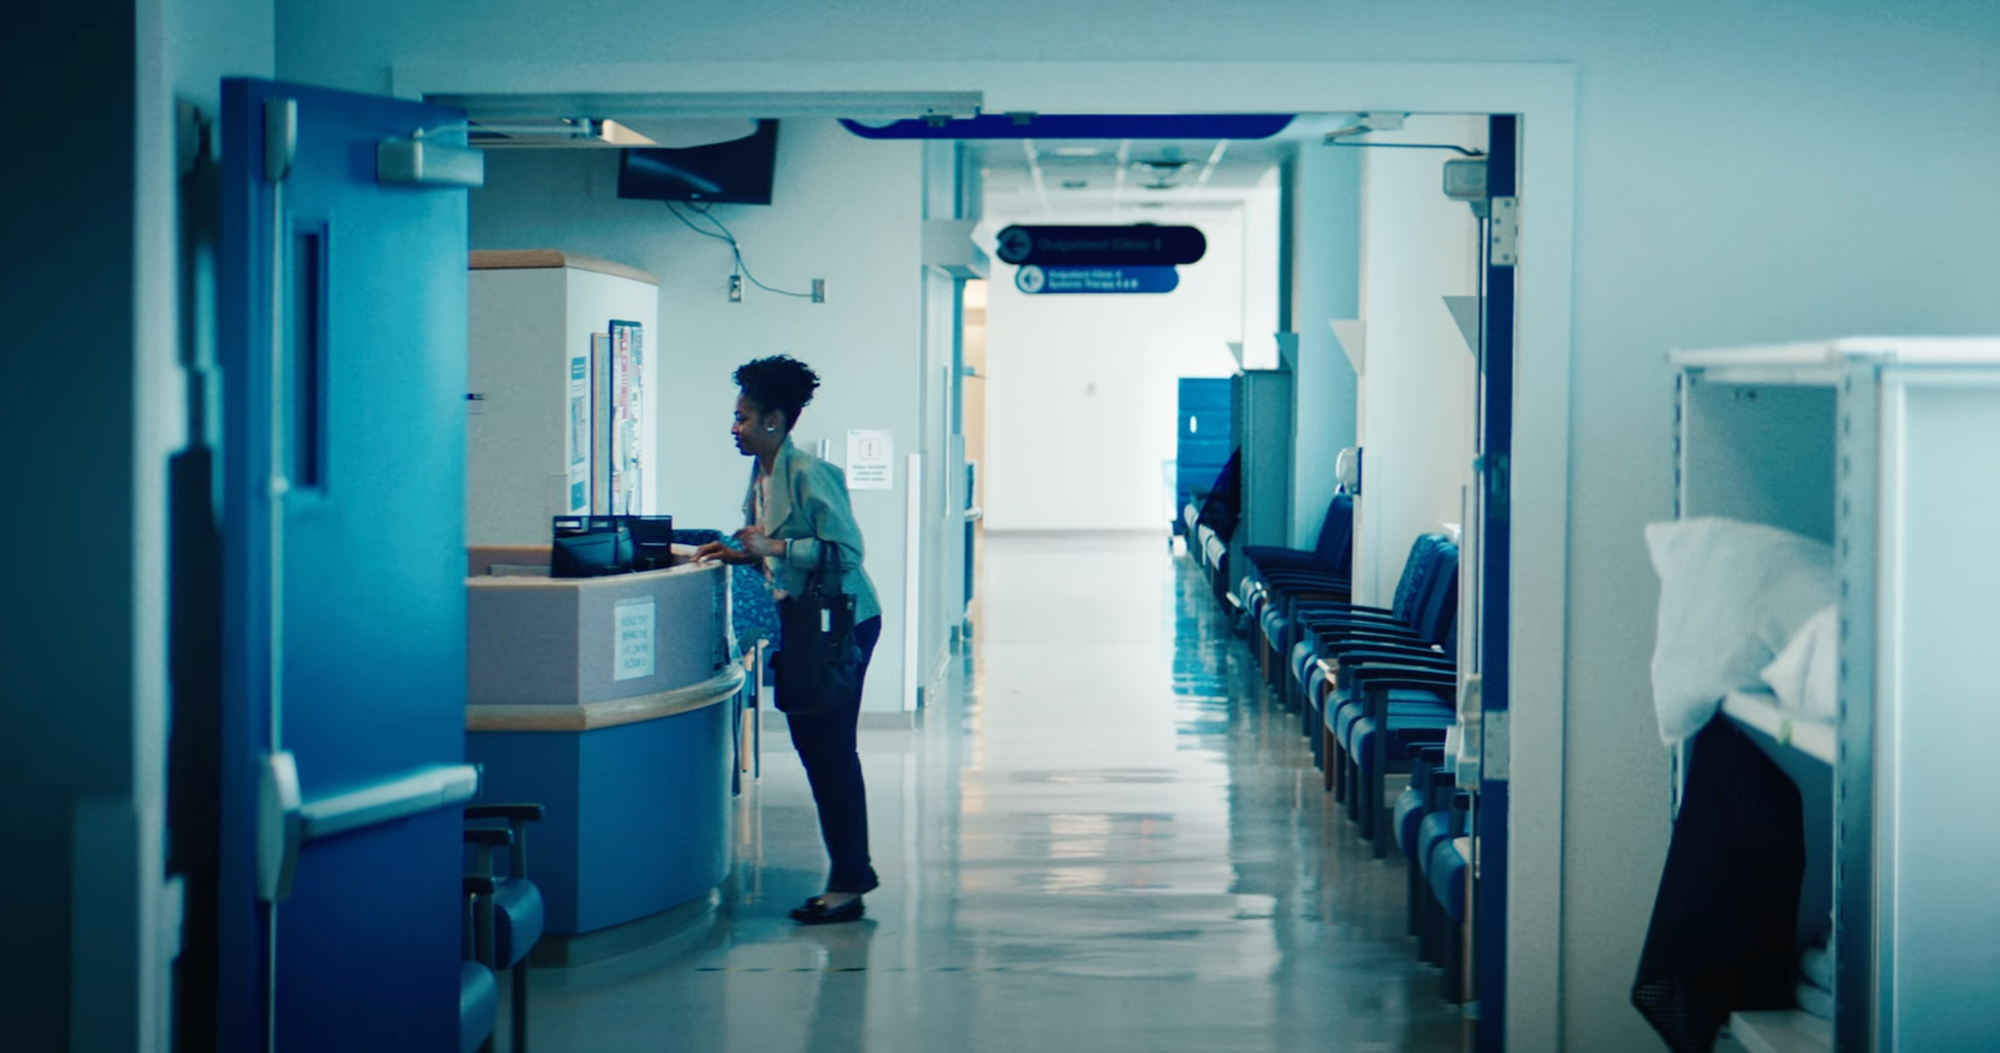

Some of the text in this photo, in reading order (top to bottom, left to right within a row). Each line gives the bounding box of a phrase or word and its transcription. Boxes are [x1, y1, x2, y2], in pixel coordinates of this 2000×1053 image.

[1036, 237, 1107, 253] Outpatient
[1111, 237, 1148, 251] Clinic
[1048, 269, 1089, 280] Outpatient
